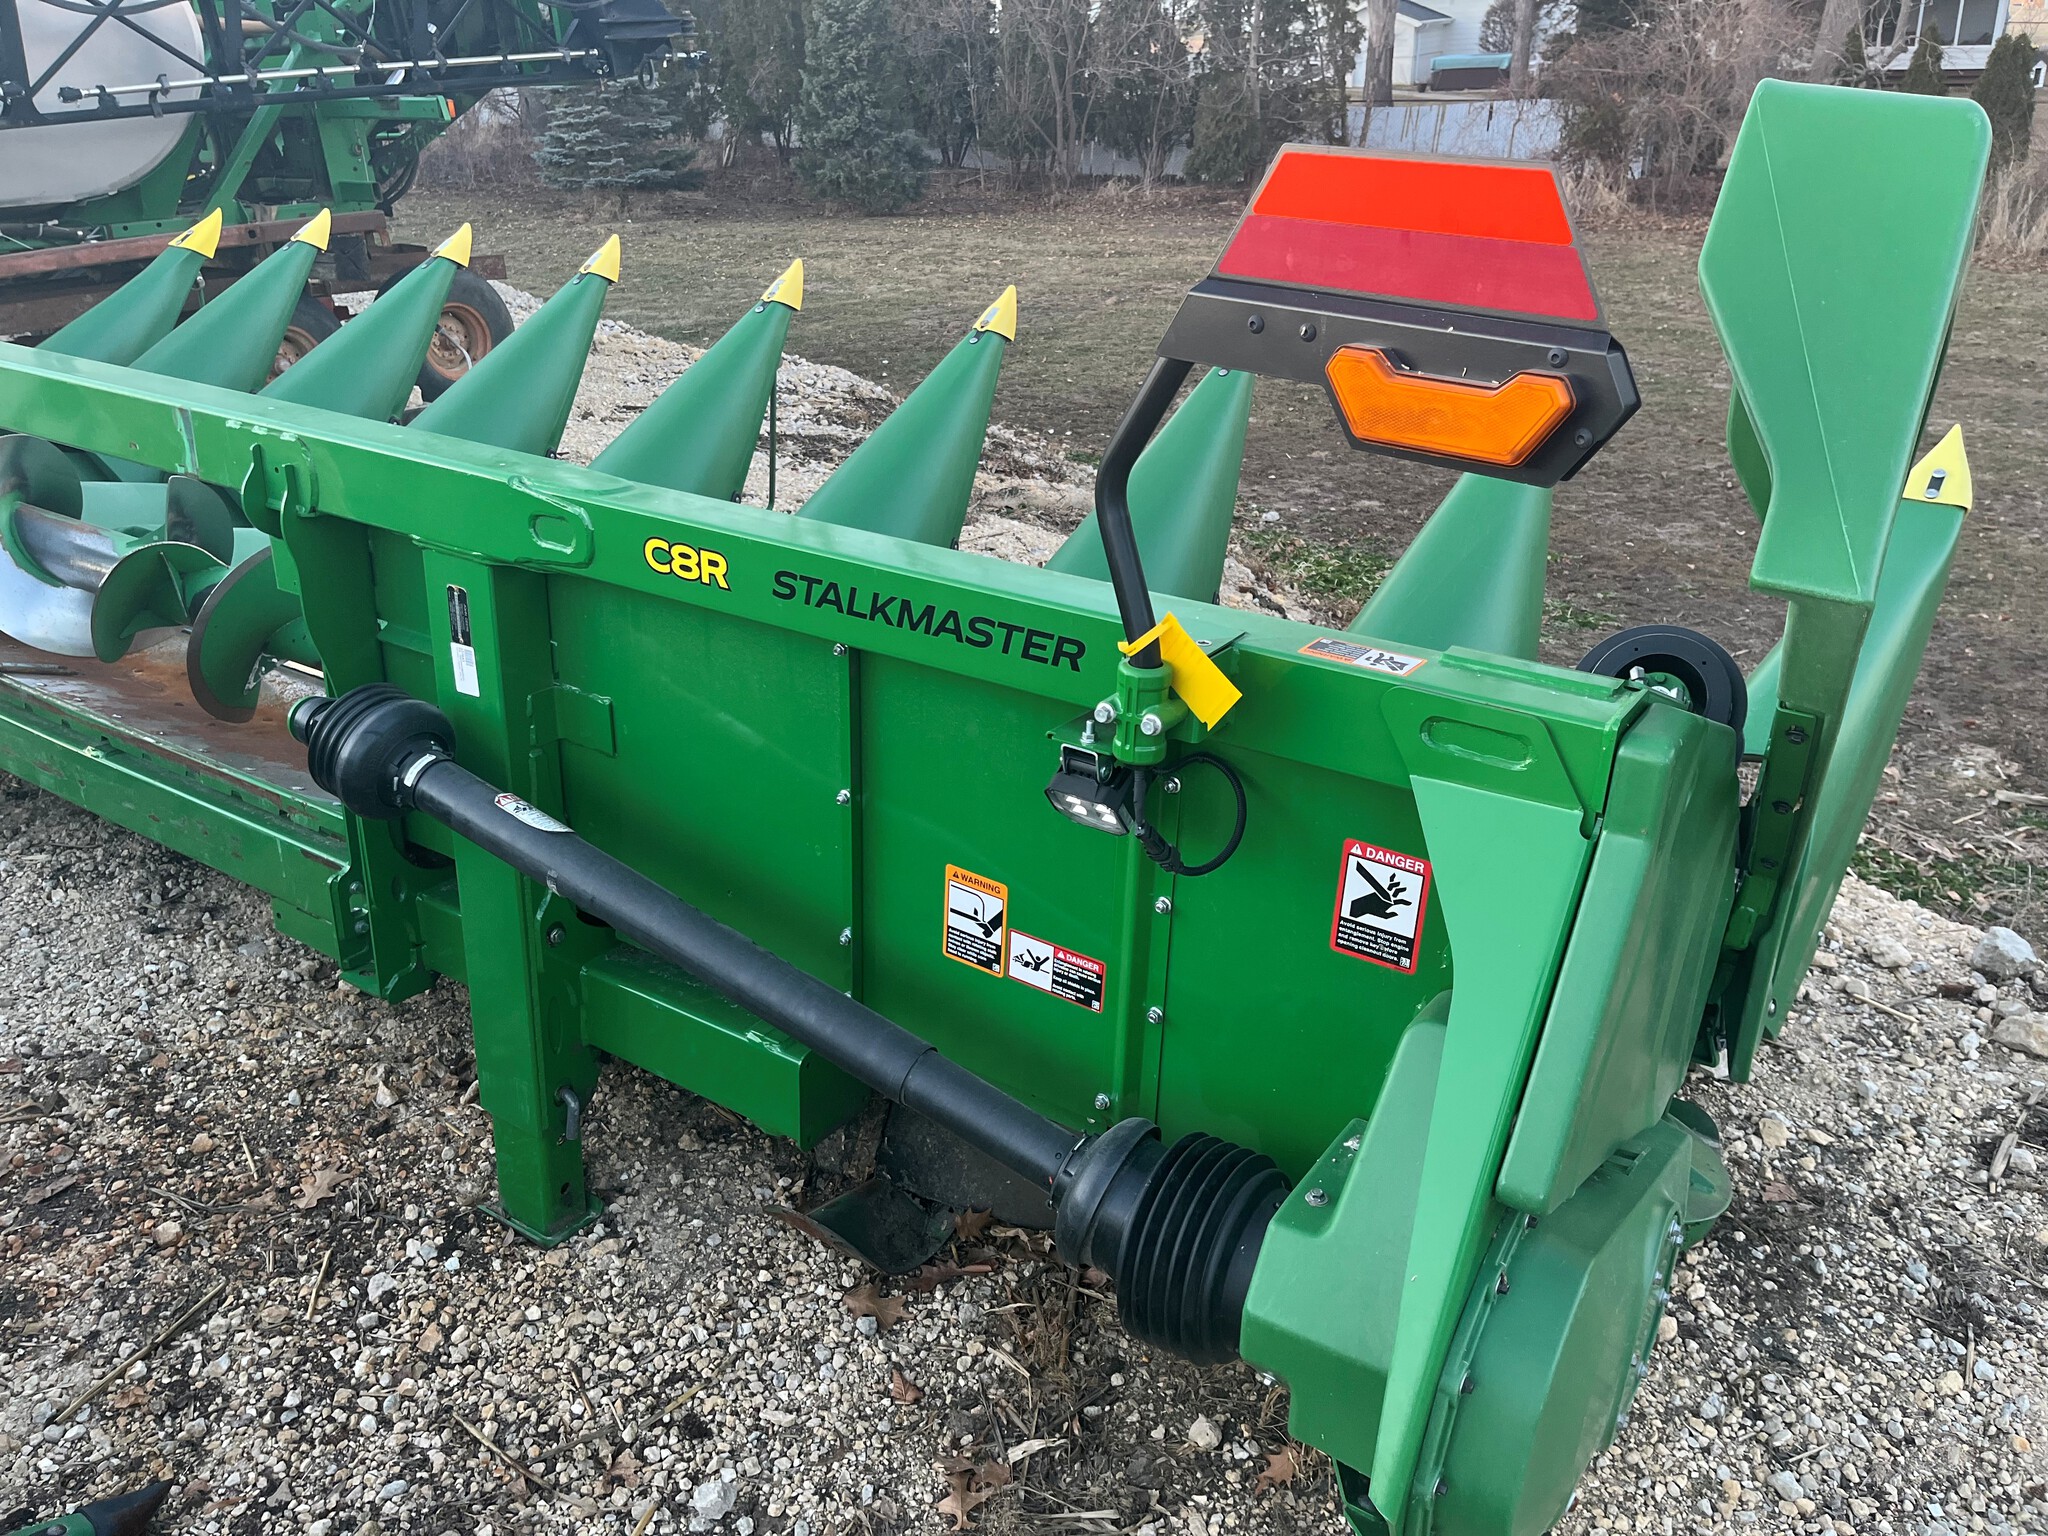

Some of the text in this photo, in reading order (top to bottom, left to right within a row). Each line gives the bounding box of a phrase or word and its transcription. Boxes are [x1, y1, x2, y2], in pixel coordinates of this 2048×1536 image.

[643, 536, 1087, 672] C8R STALKMASTER
[1366, 847, 1424, 874] DANGER
[960, 873, 1001, 894] WARNING
[1338, 932, 1348, 940] and
[1349, 937, 1369, 945] remove
[1340, 920, 1407, 945] Avoid serious injury from
[1337, 939, 1358, 950] opening
[1359, 945, 1382, 956] cleanout
[1377, 937, 1390, 946] Stop
[1391, 943, 1410, 952] engine
[1066, 954, 1099, 972] DANGER
